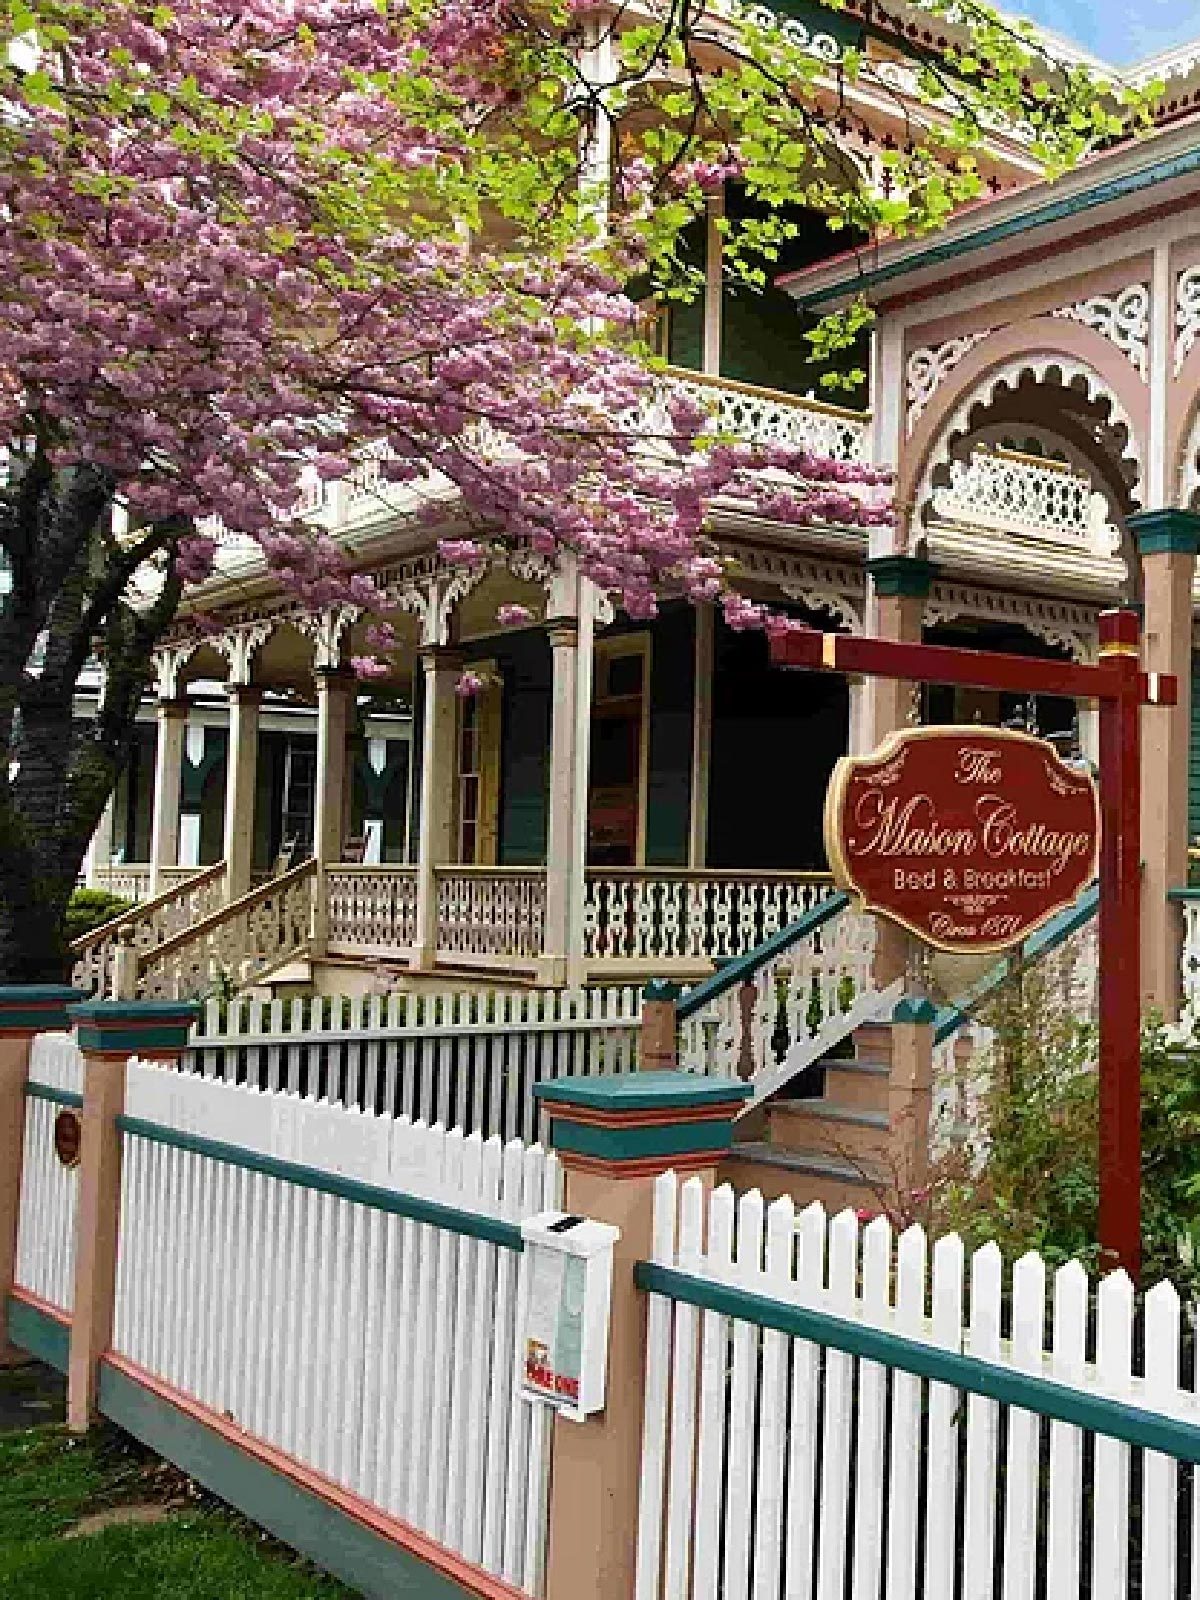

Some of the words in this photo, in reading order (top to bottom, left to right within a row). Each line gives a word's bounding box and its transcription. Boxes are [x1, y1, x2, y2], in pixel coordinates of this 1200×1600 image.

[954, 747, 1002, 783] The
[848, 788, 978, 856] Mason
[975, 794, 1091, 875] Cottage
[893, 867, 936, 890] Bed
[942, 867, 959, 890] &
[965, 866, 1051, 890] Breakfast
[928, 911, 977, 938] Circa
